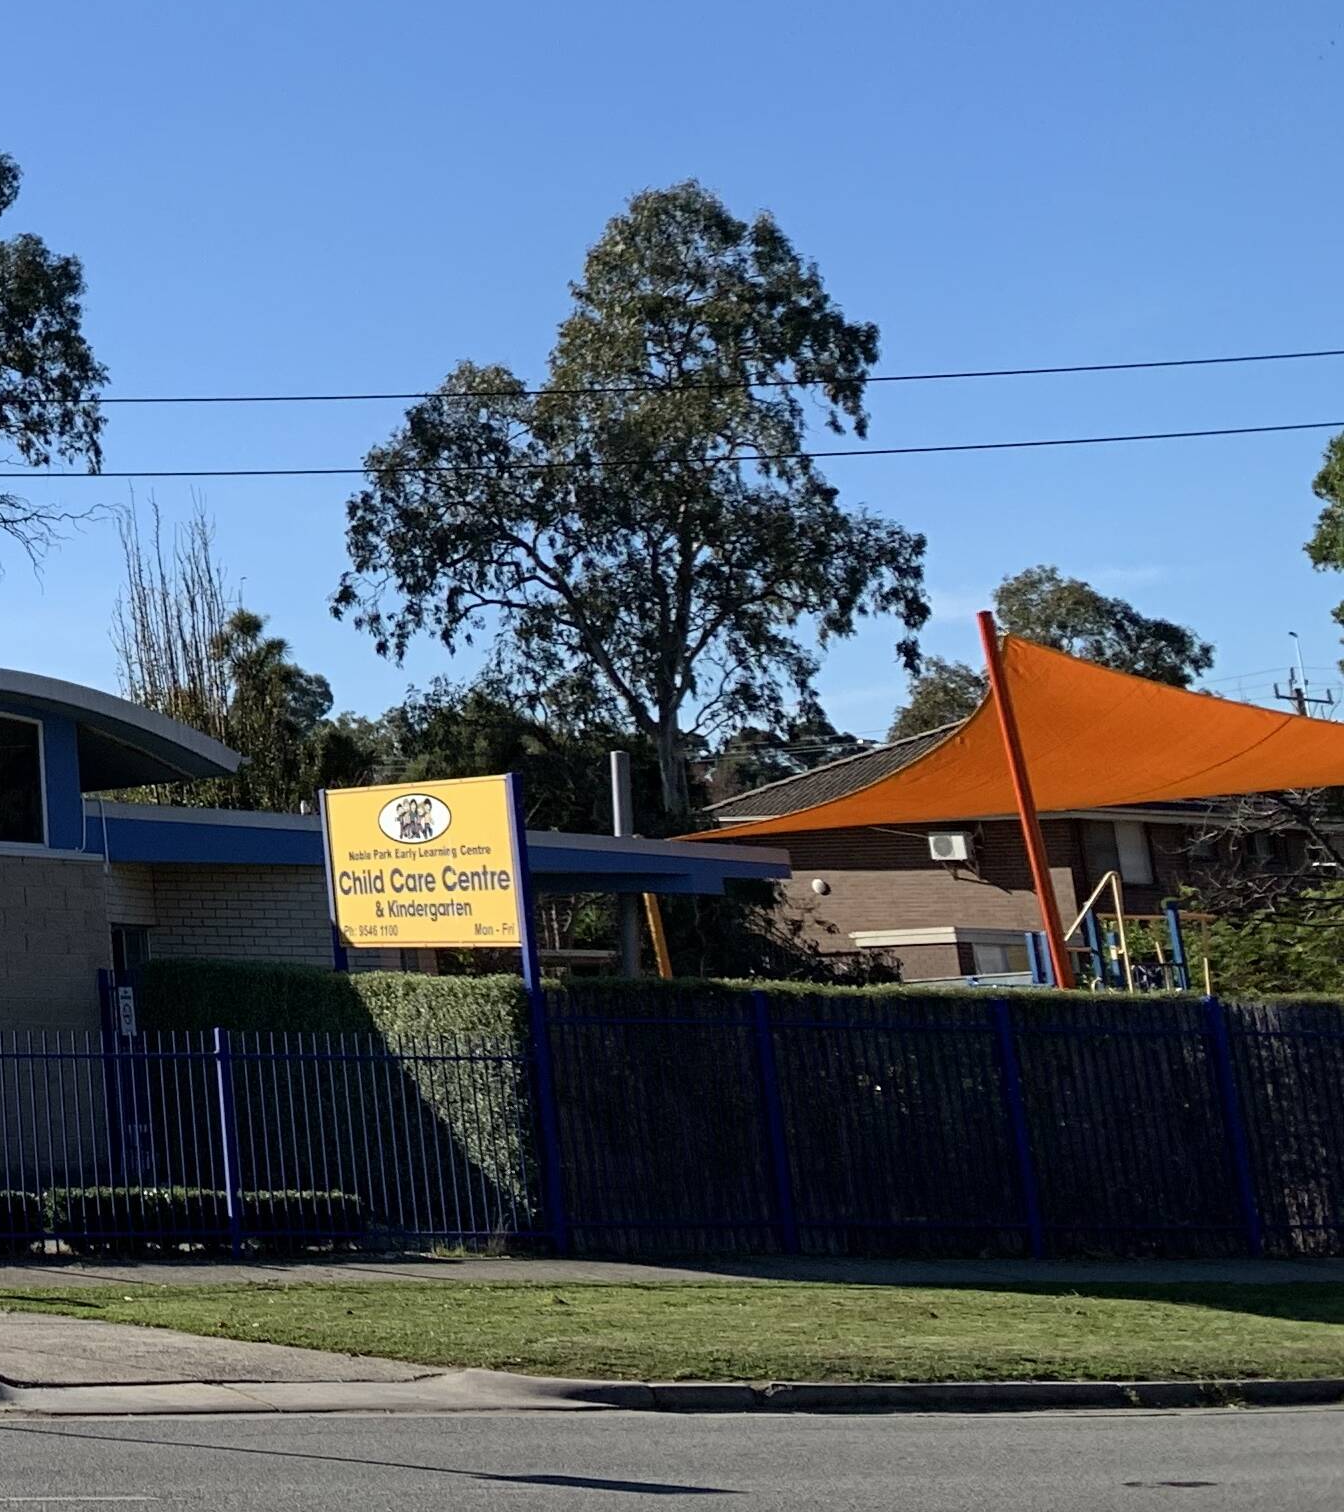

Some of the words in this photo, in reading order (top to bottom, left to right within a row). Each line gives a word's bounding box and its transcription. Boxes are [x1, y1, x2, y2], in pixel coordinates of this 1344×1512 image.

[348, 850, 371, 862] Noble
[373, 849, 392, 860] Park
[394, 848, 416, 861] Early
[418, 846, 458, 859] Learning
[459, 844, 492, 856] Centre
[338, 869, 385, 896] Child
[390, 867, 436, 894] Care
[442, 864, 511, 891] Centre
[375, 900, 385, 918] &
[387, 897, 473, 922] Kindergarten
[343, 925, 357, 936] Ph:
[358, 924, 378, 936] 9546
[380, 924, 399, 936] 1100
[474, 923, 494, 935] Mon
[502, 922, 515, 935] Fri
